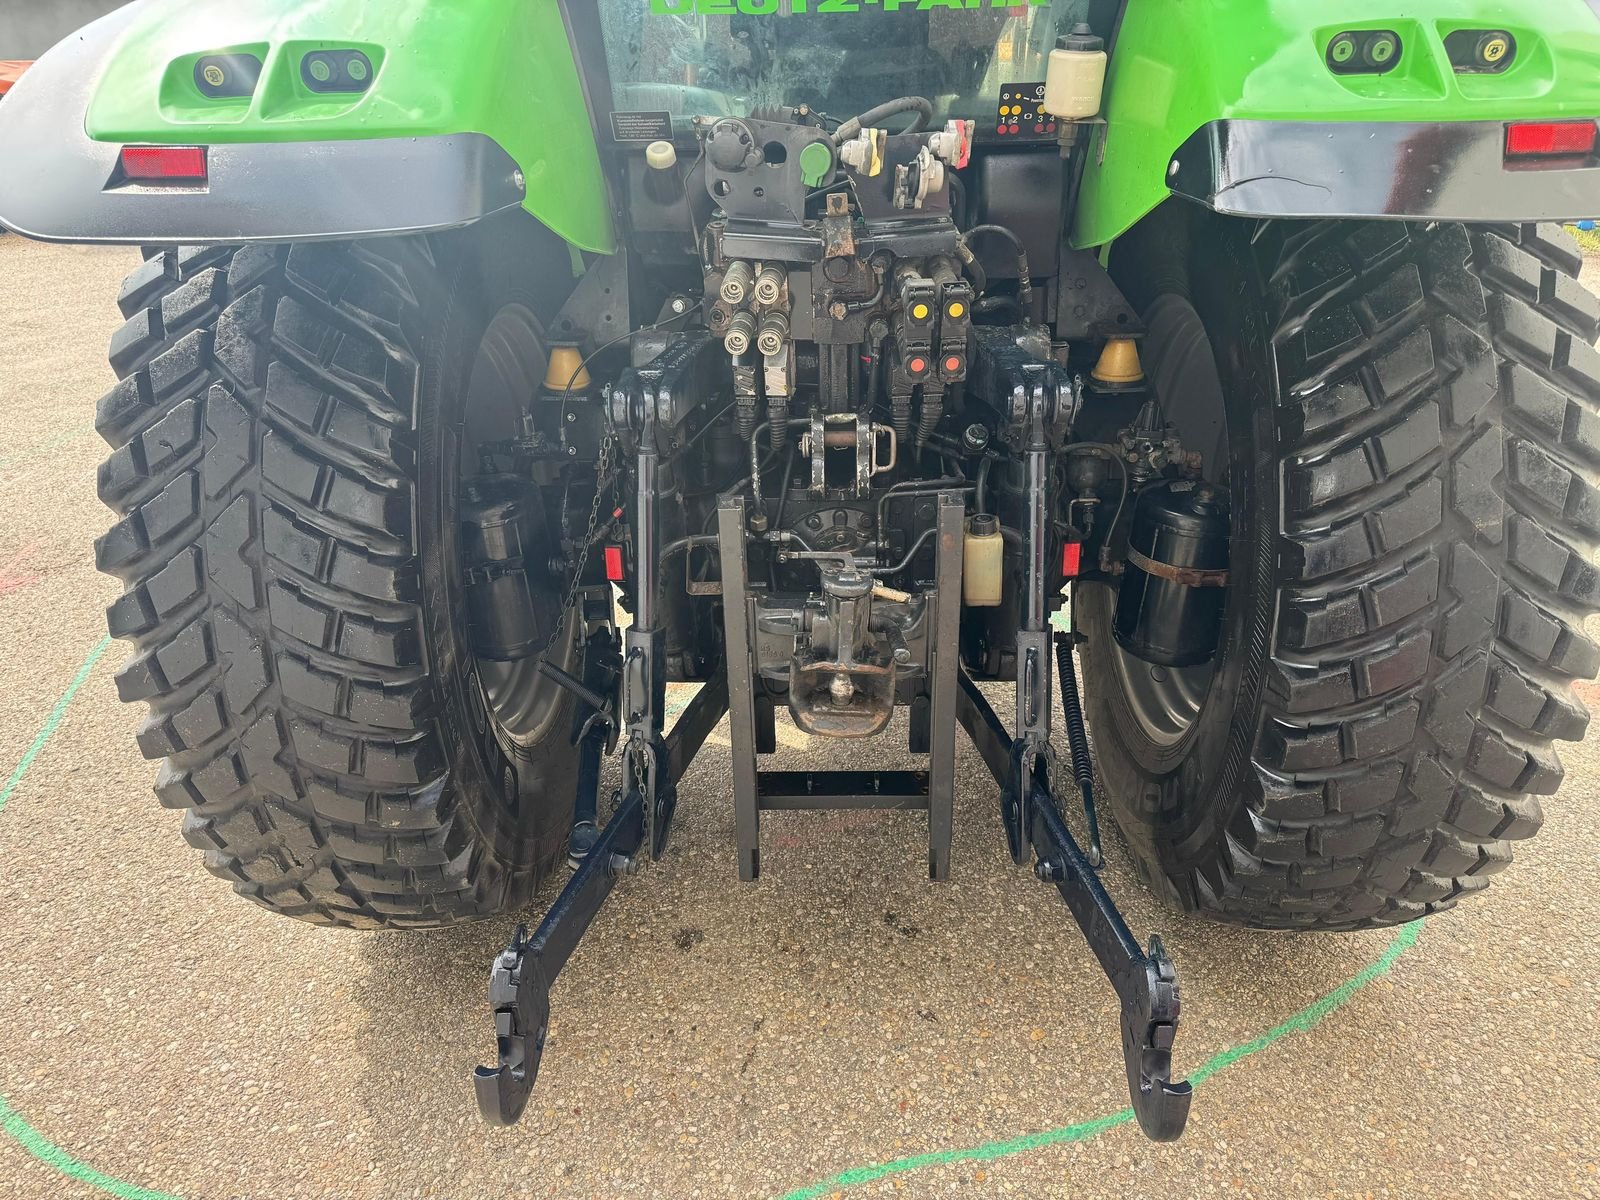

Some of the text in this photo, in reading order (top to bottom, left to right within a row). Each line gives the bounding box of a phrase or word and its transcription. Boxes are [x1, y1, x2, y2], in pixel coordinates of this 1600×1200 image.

[650, 0, 1053, 15] DEUTZ-FA
[1001, 114, 1055, 124] 1 2 3 4
